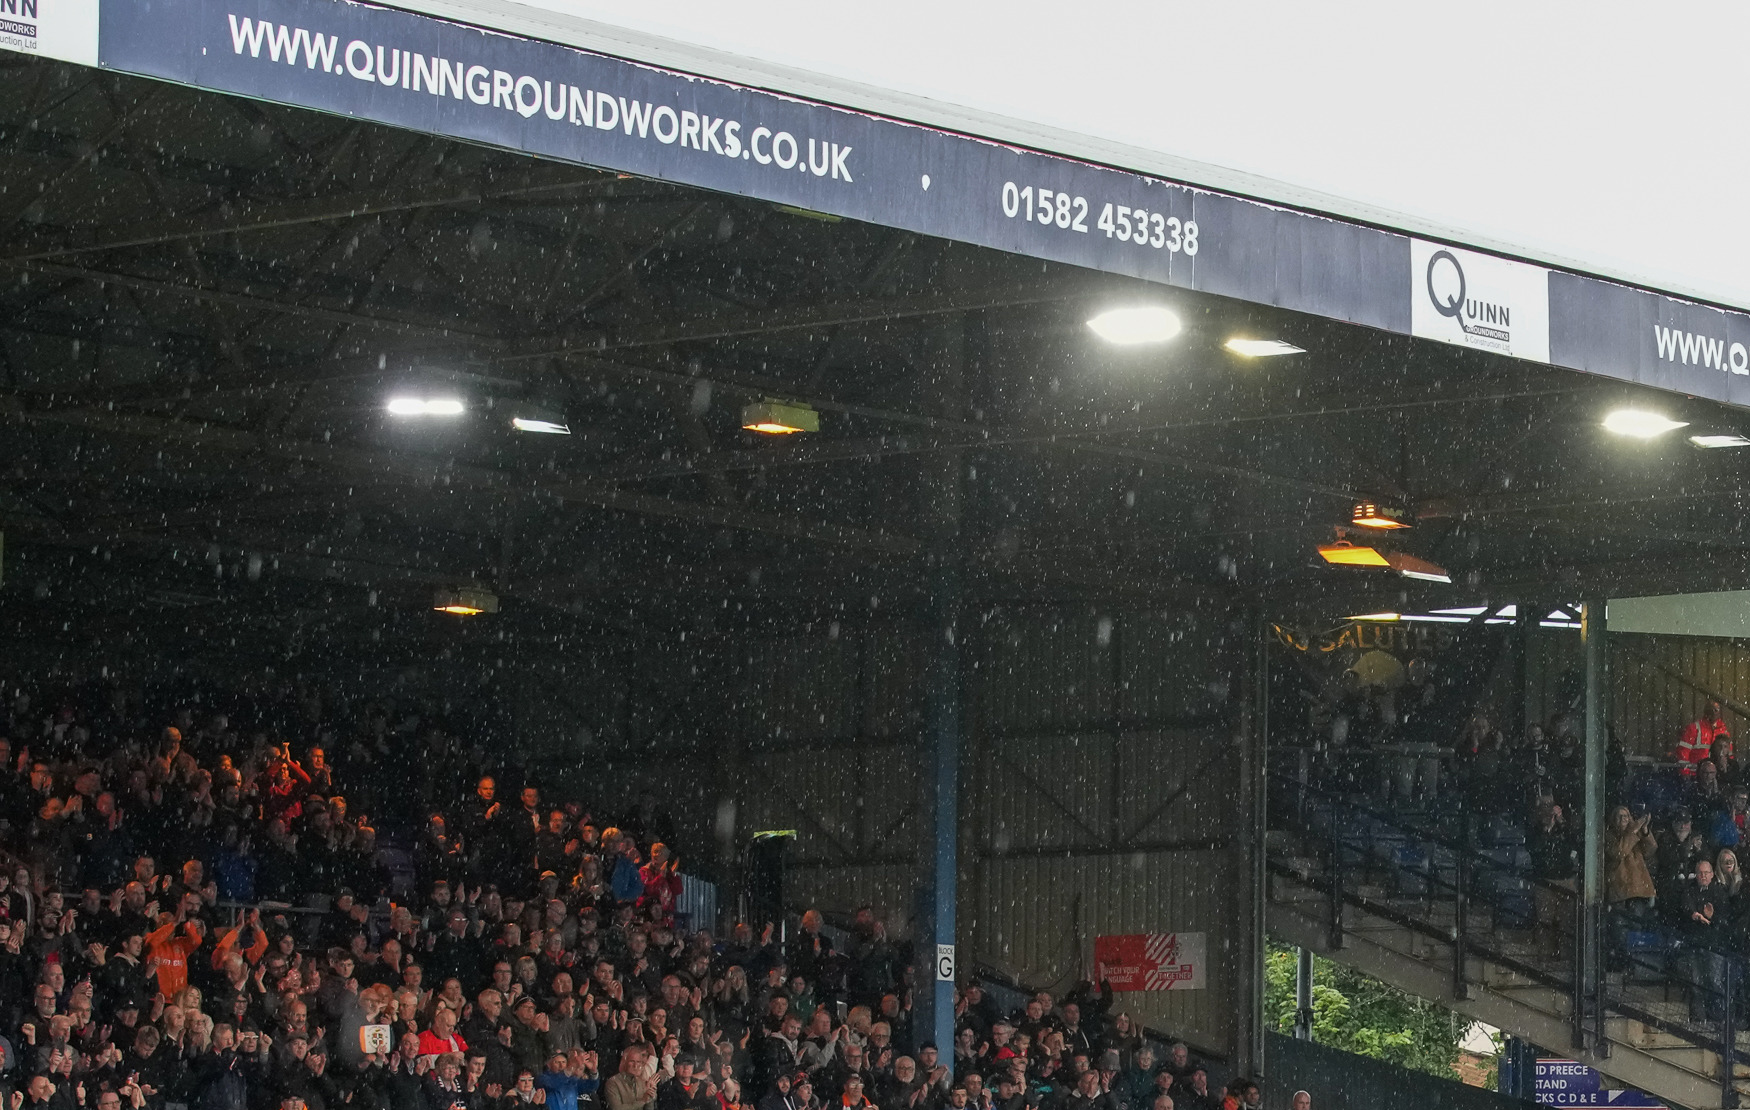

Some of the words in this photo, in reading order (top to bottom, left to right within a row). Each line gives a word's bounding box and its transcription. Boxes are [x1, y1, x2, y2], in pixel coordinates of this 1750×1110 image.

[25, 41, 37, 49] Ltd
[228, 14, 853, 183] WWW.QUINNGROUNDWORKS.CO.UK
[1002, 182, 1068, 233] 01582
[1098, 203, 1199, 256] 453338
[1427, 250, 1510, 328] QUINN
[1465, 326, 1509, 341] GROUNDWORKS
[1470, 337, 1501, 350] Construction
[939, 956, 953, 978] G
[1550, 1065, 1588, 1076] PREECE
[1557, 1093, 1566, 1103] C
[1570, 1093, 1577, 1103] D
[1580, 1093, 1587, 1103] &
[1591, 1093, 1596, 1103] E
